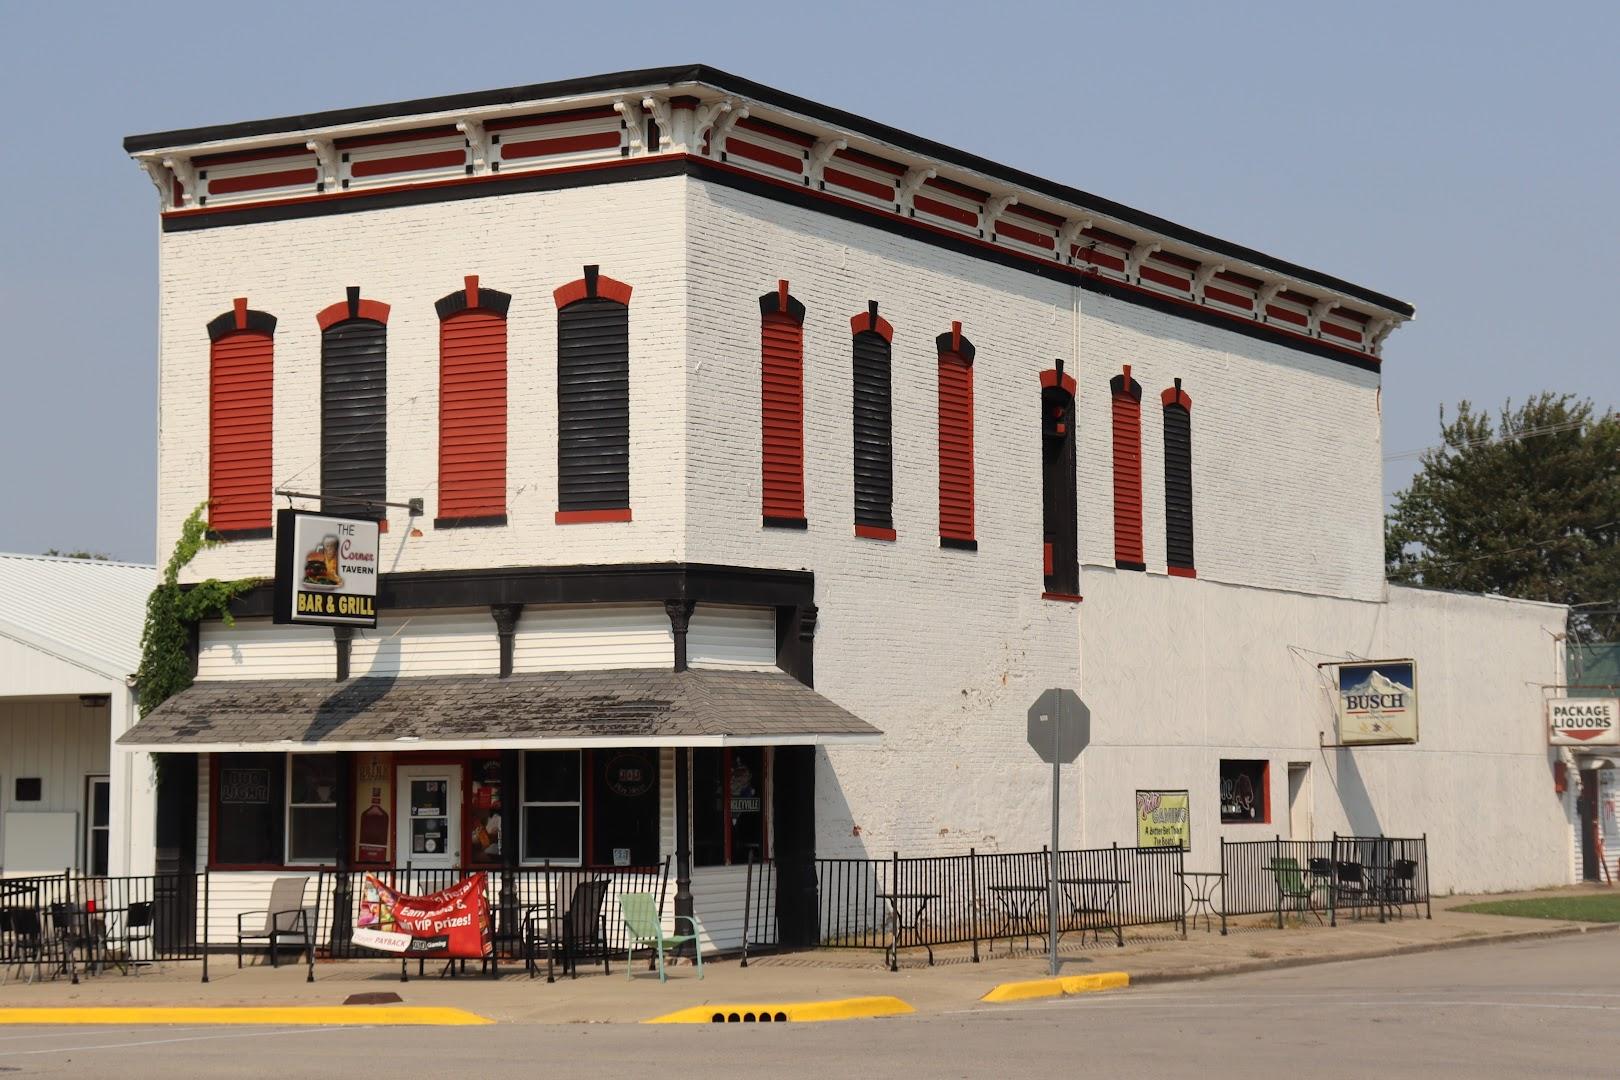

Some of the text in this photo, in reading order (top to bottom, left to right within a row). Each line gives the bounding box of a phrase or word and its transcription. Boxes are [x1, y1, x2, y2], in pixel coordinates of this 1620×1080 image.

[338, 523, 355, 536] THE
[341, 539, 375, 561] Corner
[341, 565, 374, 574] TAVERN
[298, 593, 374, 615] BAR & GRILL
[1346, 694, 1404, 710] BUSCH
[1554, 706, 1610, 716] PACKAGE
[1554, 717, 1611, 728] LIQUORS
[400, 906, 425, 918] Earn
[456, 899, 467, 909] &
[415, 918, 431, 931] VIP
[434, 914, 471, 933] prizes!
[374, 937, 406, 948] PAYBACK
[427, 940, 447, 949] Gaming
